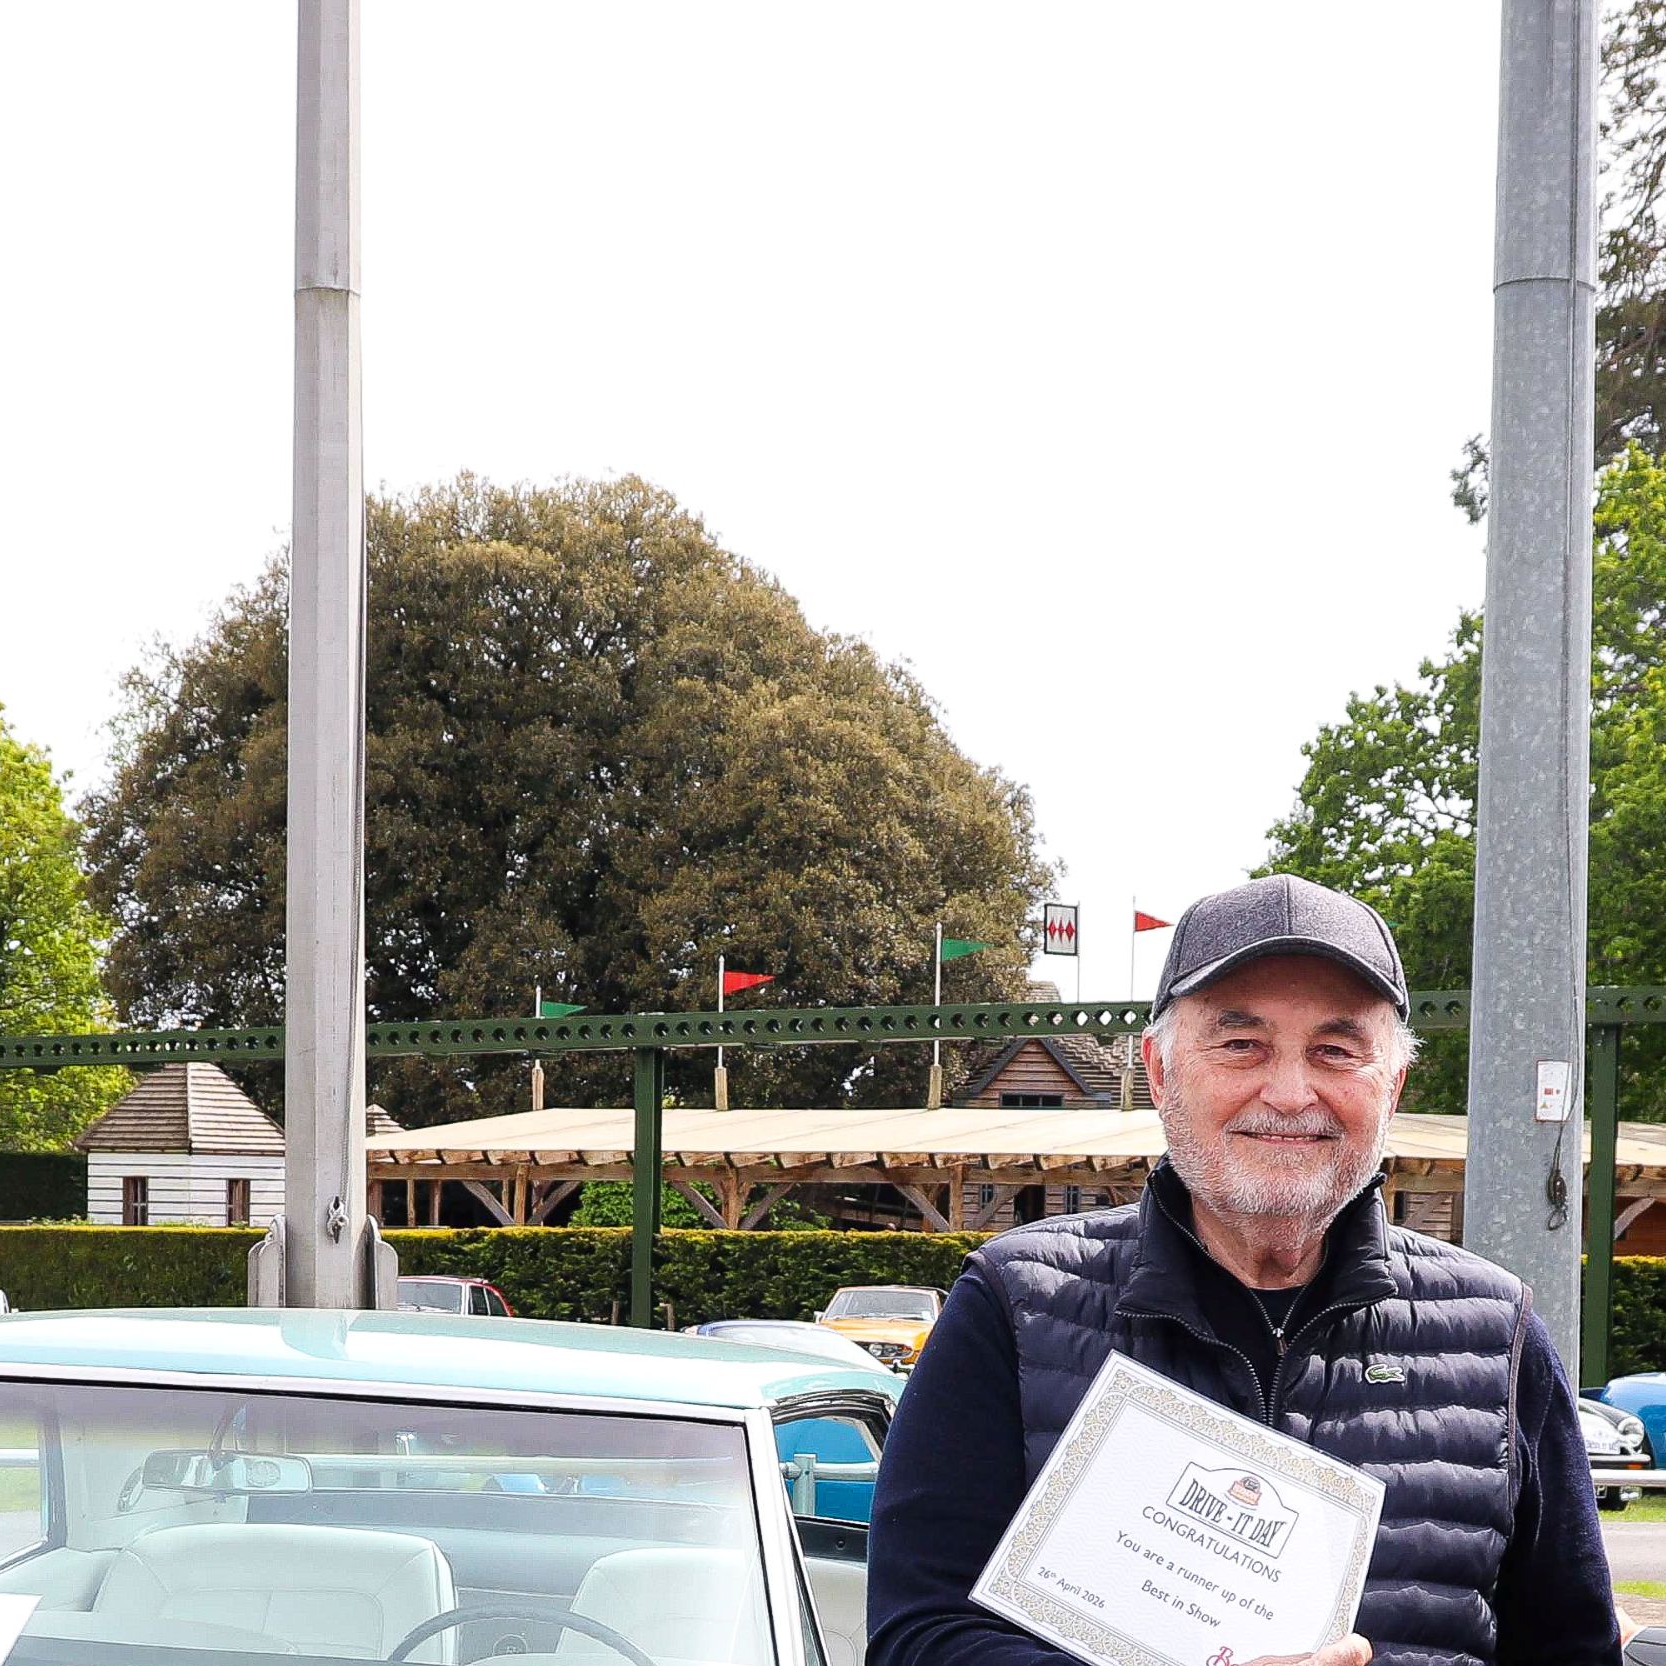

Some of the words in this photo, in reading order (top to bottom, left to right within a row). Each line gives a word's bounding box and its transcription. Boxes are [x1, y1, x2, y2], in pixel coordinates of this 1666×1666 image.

[1142, 1505, 1282, 1583] CONGRATULATIONS
[1179, 1478, 1228, 1524] DRIVE
[1231, 1512, 1253, 1536] IT
[1249, 1518, 1287, 1548] DAY
[1056, 1577, 1082, 1597] April
[1083, 1589, 1106, 1609] 2026
[1116, 1530, 1141, 1552] You
[1143, 1548, 1165, 1566] are
[1166, 1561, 1176, 1571] a
[1177, 1566, 1219, 1593] runner
[1221, 1588, 1236, 1604] up
[1239, 1595, 1255, 1609] of
[1255, 1603, 1274, 1620] the
[1141, 1579, 1169, 1603] Best
[1171, 1595, 1184, 1611] in
[1187, 1603, 1221, 1628] Show
